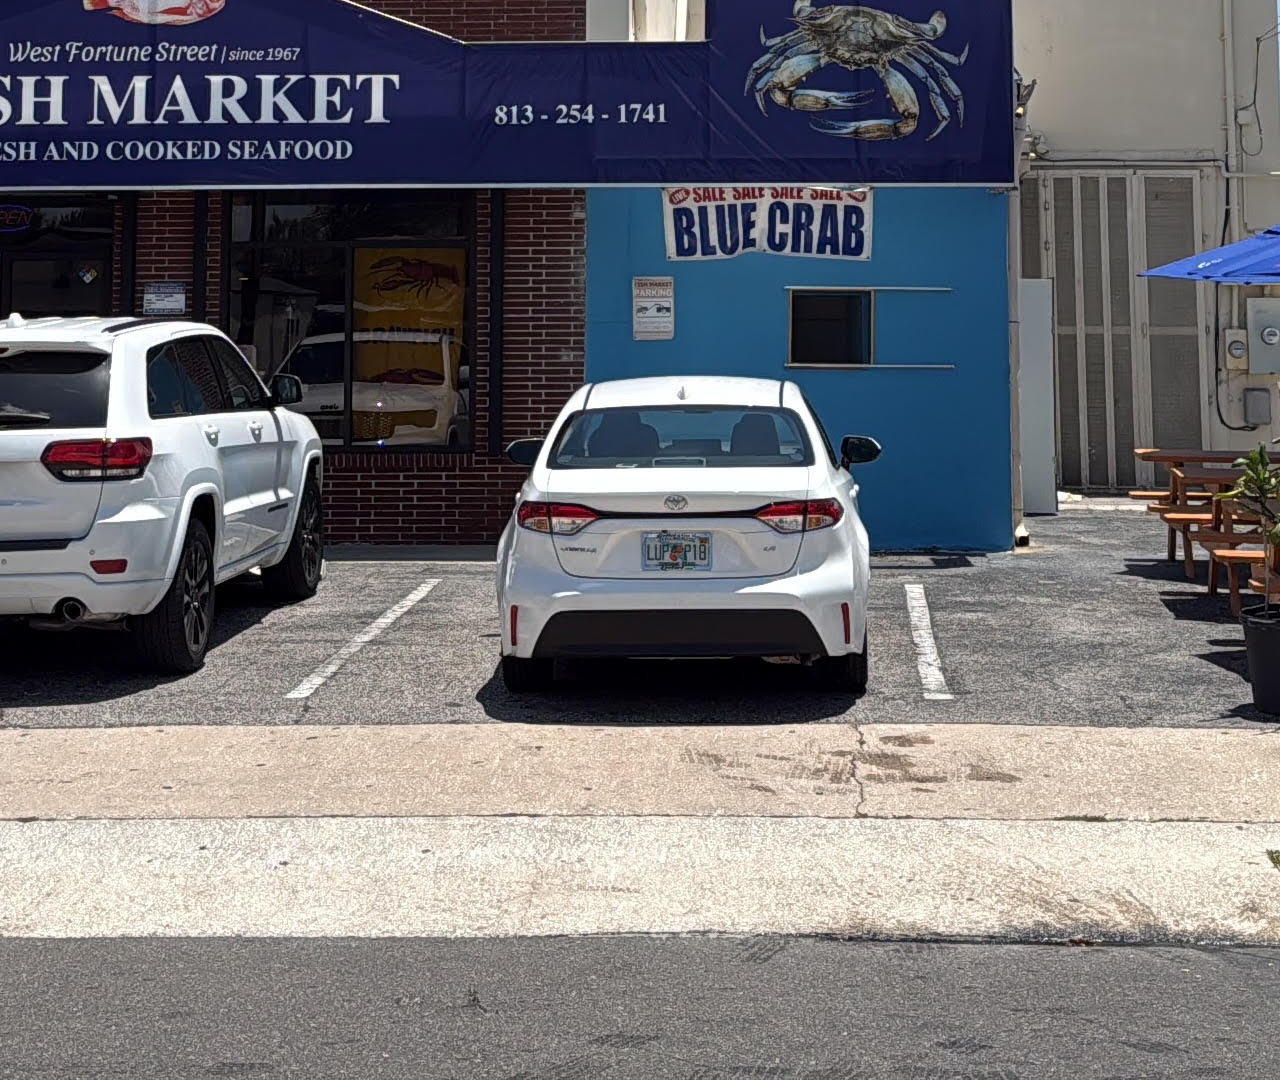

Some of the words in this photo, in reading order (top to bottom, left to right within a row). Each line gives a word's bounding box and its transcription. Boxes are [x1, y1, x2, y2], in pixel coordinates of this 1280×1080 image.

[8, 41, 61, 62] West
[65, 41, 152, 62] Fortune
[155, 42, 218, 62] Street
[228, 48, 265, 61] since
[266, 48, 300, 61] 1967
[86, 74, 400, 126] MARKET
[494, 104, 534, 125] 813
[555, 103, 595, 124] 254
[617, 102, 668, 124] 1741
[43, 141, 99, 162] AND
[106, 140, 220, 161] COOKED
[227, 139, 353, 161] SEAFOOD
[693, 186, 727, 203] SALE
[733, 187, 765, 201] SALE
[770, 186, 804, 200] SALE
[673, 203, 757, 257] BLUE
[767, 201, 865, 257] CRAB
[647, 544, 669, 561] LUP
[684, 544, 706, 561] P18
